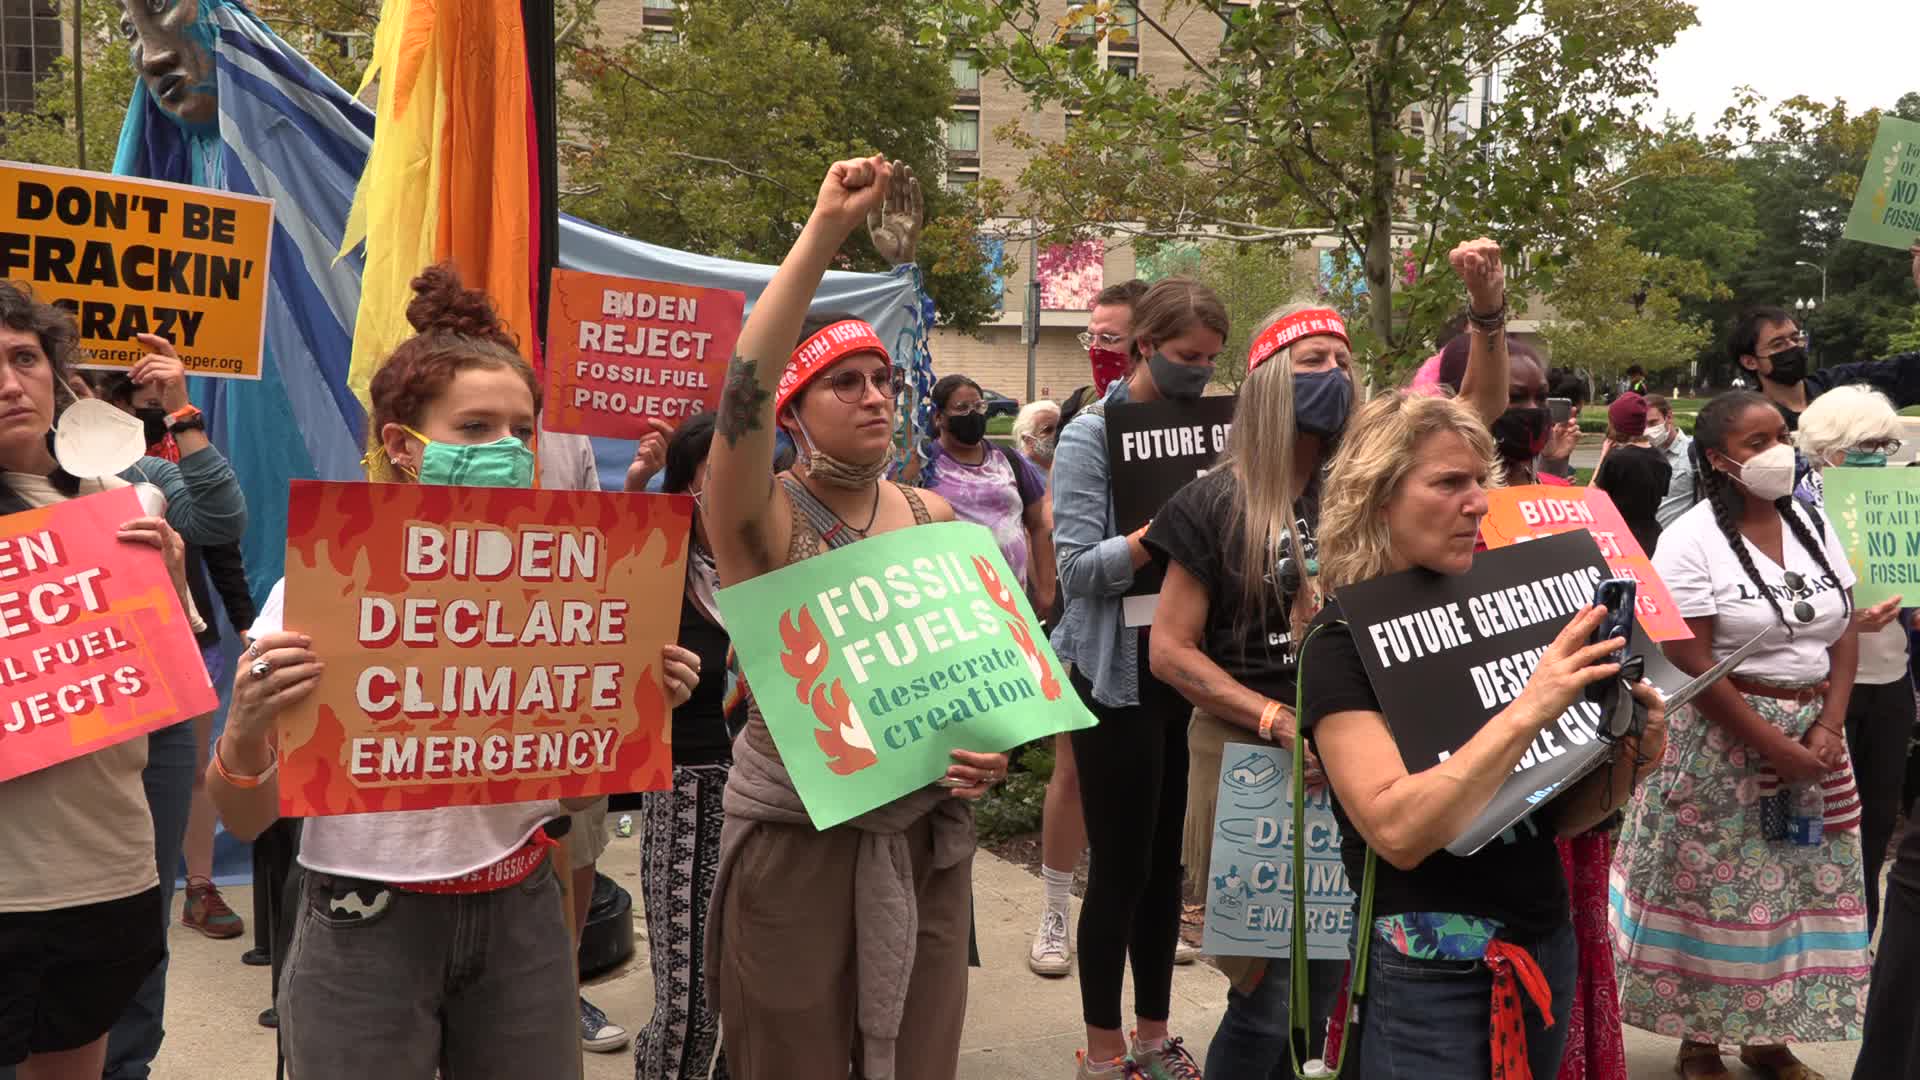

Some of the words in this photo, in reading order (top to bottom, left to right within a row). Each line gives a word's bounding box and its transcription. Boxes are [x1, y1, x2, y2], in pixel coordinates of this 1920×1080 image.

[17, 181, 168, 234] DON'T
[183, 203, 236, 244] BE
[0, 231, 254, 300] FRACKIN'
[602, 289, 696, 323] BIDEN
[579, 320, 712, 360] REJECT
[1277, 321, 1310, 345] PEOPLE
[576, 361, 655, 385] FOSSIL
[660, 369, 708, 388] FUEL
[574, 388, 704, 417] PROJECTS
[1122, 426, 1206, 461] FUTURE
[1519, 498, 1594, 525] BIDEN
[405, 527, 595, 578] BIDEN
[1868, 532, 1896, 557] NO
[817, 552, 979, 638] FOSSIL
[1871, 563, 1920, 584] FOSSIL
[359, 597, 627, 644] DECLARE
[1368, 602, 1472, 668] FUTURE
[1468, 566, 1601, 638] GENERATIONS
[32, 627, 127, 672] FUEL
[841, 600, 1000, 685] FUELS
[355, 664, 623, 713] CLIMATE
[868, 644, 1020, 716] desecrate
[883, 675, 1036, 750] creation
[351, 728, 615, 775] EMERGENCY
